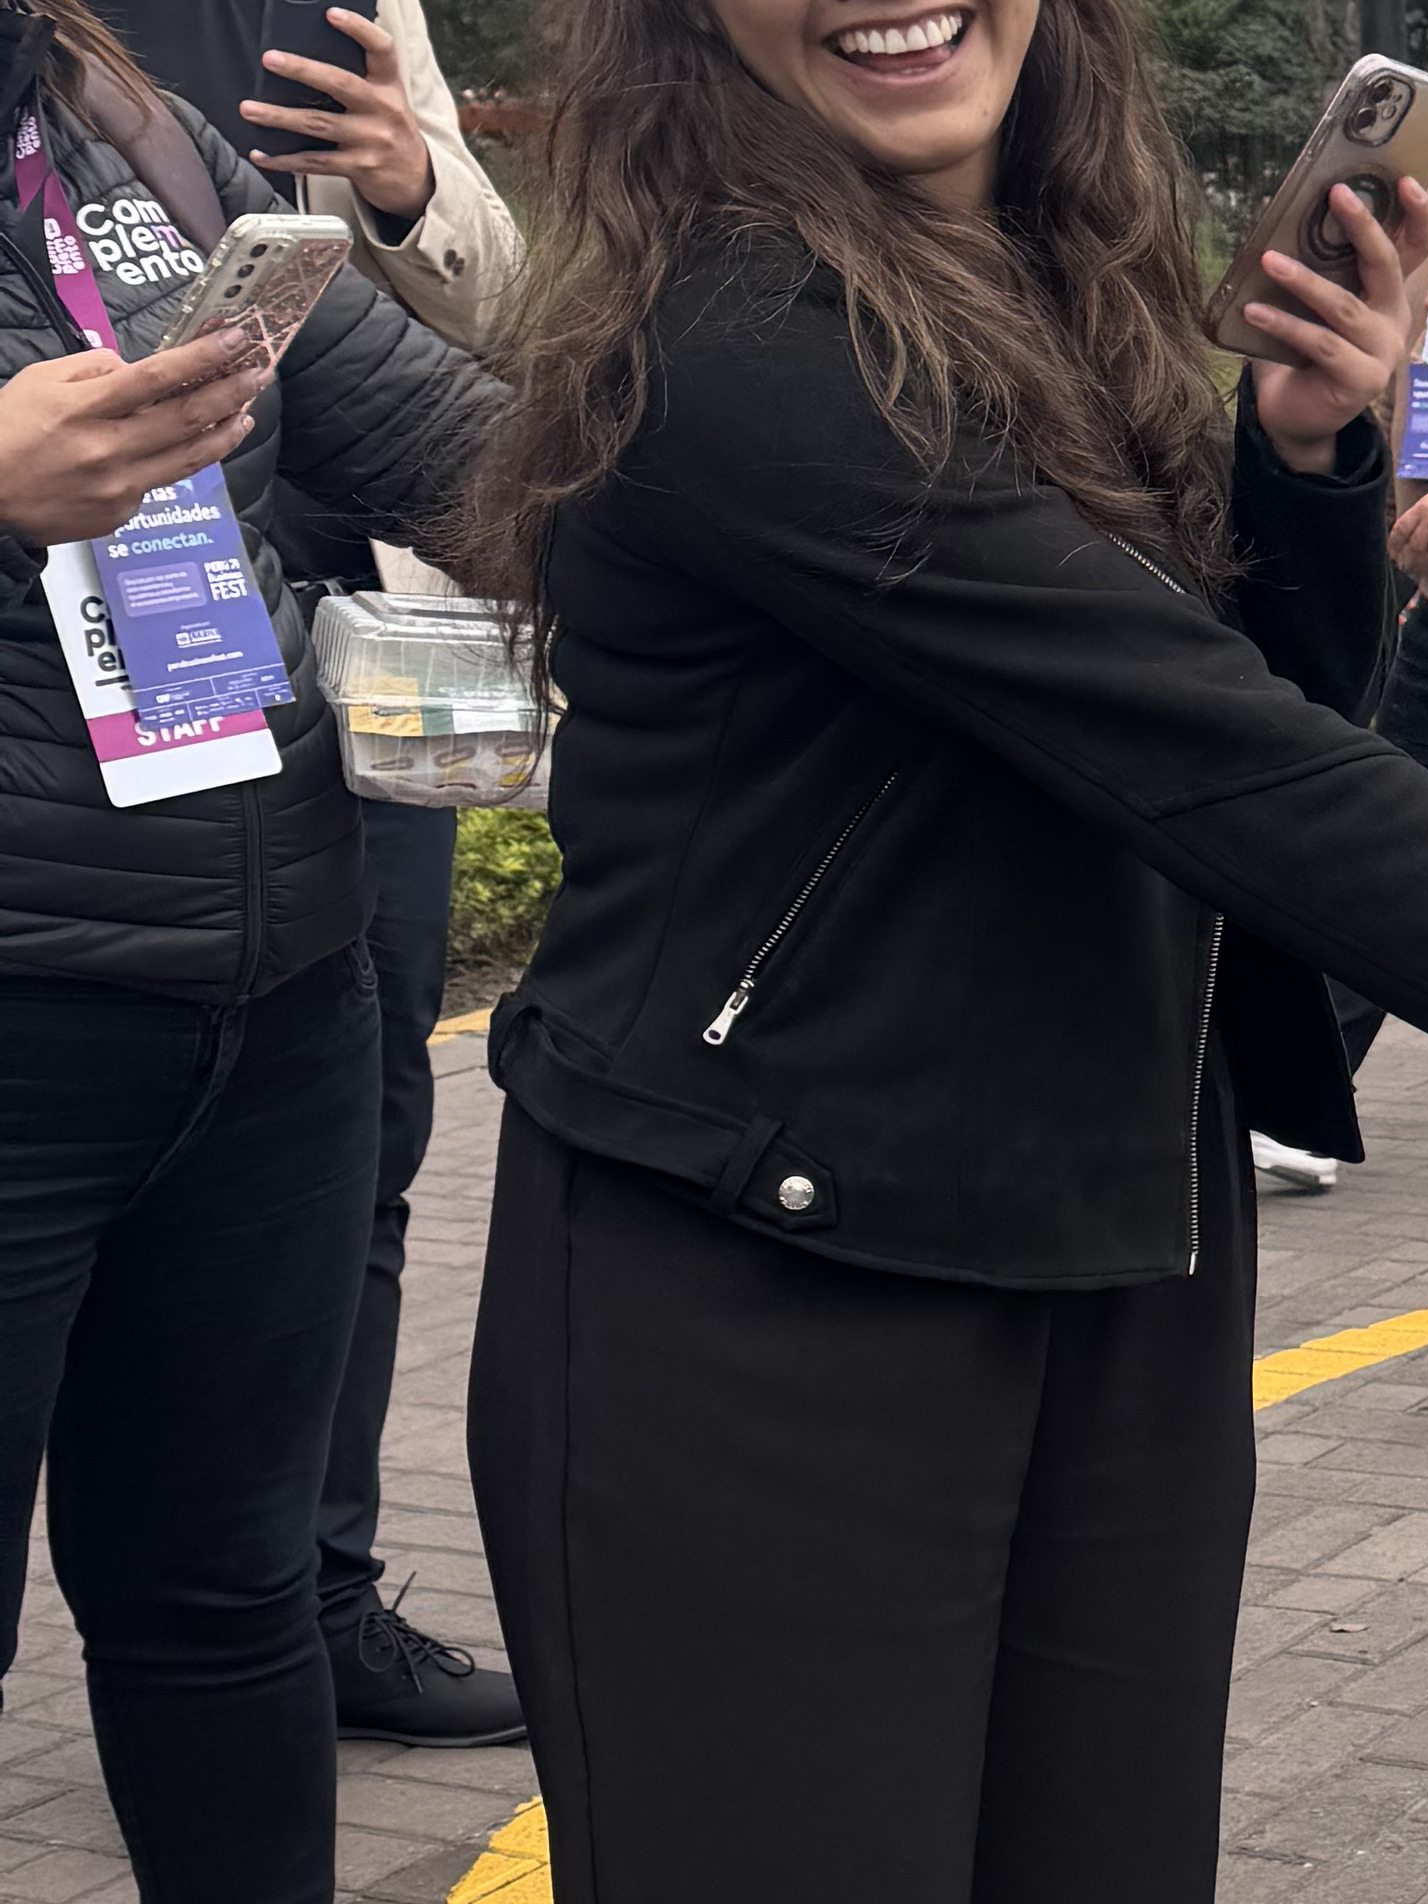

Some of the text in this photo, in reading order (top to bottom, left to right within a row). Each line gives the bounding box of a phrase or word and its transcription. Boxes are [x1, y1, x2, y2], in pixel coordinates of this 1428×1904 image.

[116, 240, 205, 285] ento
[108, 532, 214, 558] se conectan.
[210, 579, 248, 601] FEST
